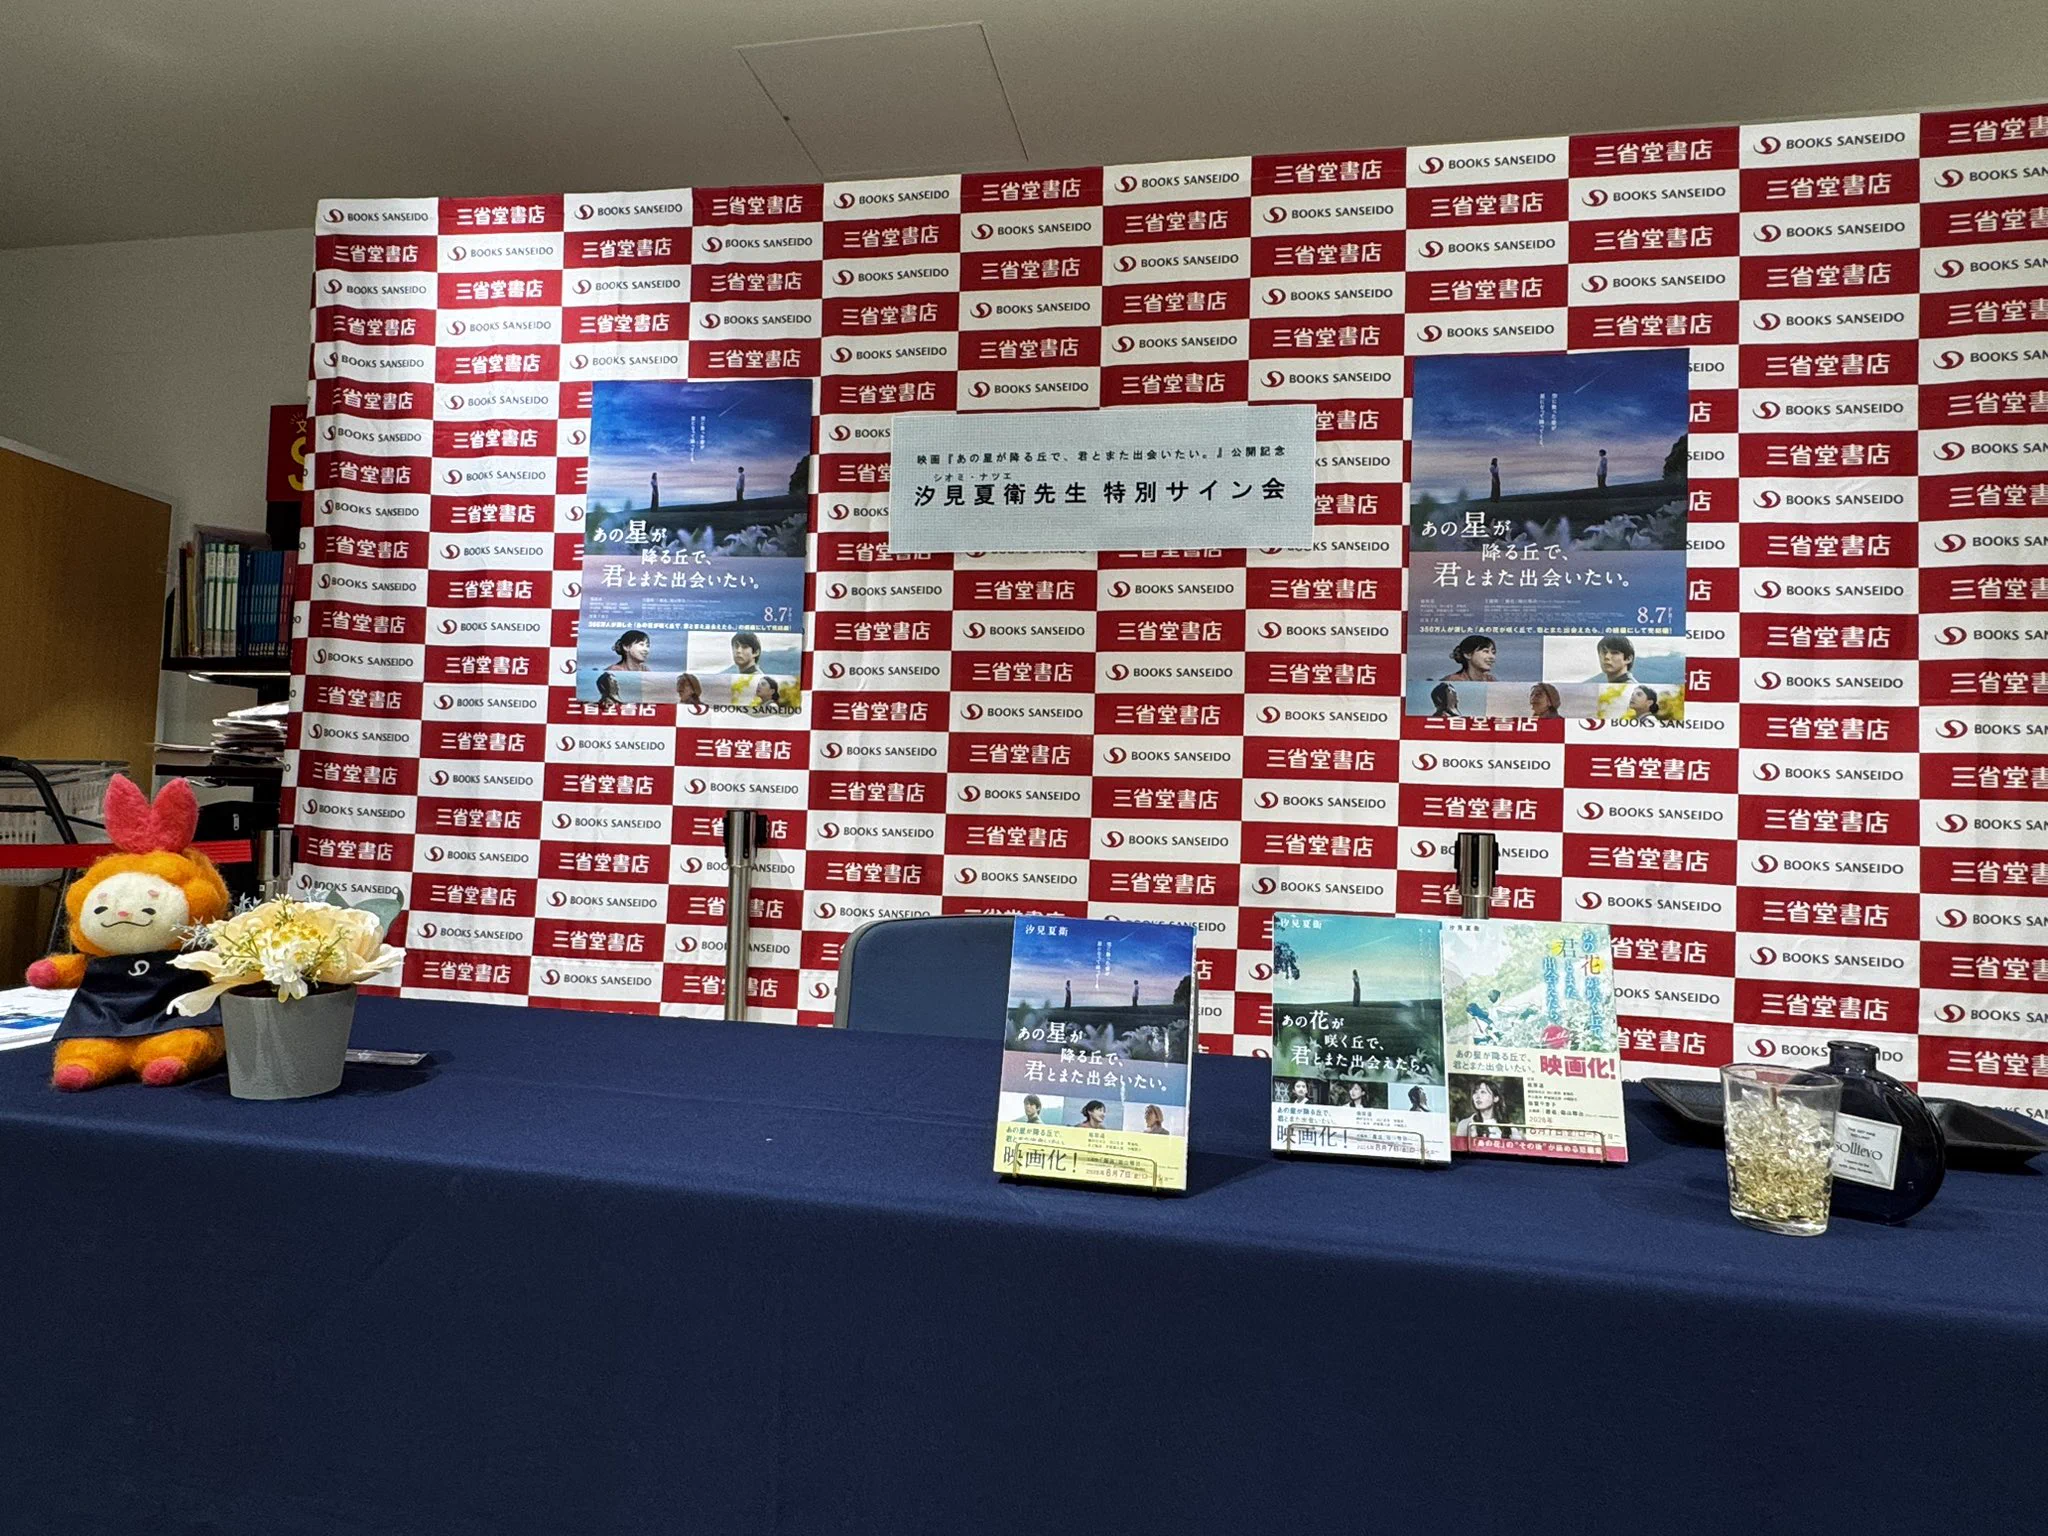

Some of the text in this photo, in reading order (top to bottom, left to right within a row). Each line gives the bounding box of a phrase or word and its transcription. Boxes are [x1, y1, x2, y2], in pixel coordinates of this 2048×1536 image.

[1786, 132, 1905, 149] BOOKS SANSEIDO
[1449, 153, 1556, 169] BOOKS SANSEIDO
[1593, 140, 1711, 164] 三省堂書店
[1142, 173, 1239, 188] BOOKS SANSEIDO
[1276, 160, 1380, 183] 三省堂書店
[984, 178, 1080, 201] 三省堂書店
[1766, 173, 1889, 199] 三省堂書店
[713, 195, 802, 215] 三省堂書店
[859, 190, 949, 205] BOOKS SANSEIDO
[598, 203, 683, 216] BOOKS SANSEIDO
[333, 245, 417, 262] 三省堂書店
[582, 238, 671, 258] 三省堂書店
[1766, 263, 1891, 287] 三省堂書店
[347, 285, 426, 295] BOOKS SANSEIDO
[1430, 278, 1540, 300] 三省堂書店
[1122, 291, 1226, 313] 三省堂書店
[724, 315, 812, 325] BOOKS SANSEIDO
[842, 304, 937, 325] 三省堂書店
[1447, 325, 1554, 337] BOOKS SANSEIDO
[1592, 314, 1711, 336] 三省堂書店
[1273, 326, 1380, 347] 三省堂書店
[981, 339, 1078, 358] 三省堂書店
[708, 349, 800, 368] 三省堂書店
[1765, 353, 1889, 376] 三省堂書店
[994, 382, 1089, 394] BOOKS SANSEIDO
[468, 396, 548, 406] BOOKS SANSEIDO
[1786, 403, 1904, 415] BOOKS SANSEIDO
[453, 429, 536, 448] 三省堂書店
[855, 428, 890, 438] BOOKS
[1766, 444, 1888, 466] 三省堂書店
[1971, 443, 2019, 454] BOOKS
[1332, 457, 1390, 467] SANSEIDO
[933, 472, 1012, 482] シオミ・ナツエ
[1316, 493, 1378, 515] 堂書店
[593, 520, 667, 544] あの星が
[1422, 511, 1511, 539] あの星が
[1482, 543, 1568, 562] 降る丘で、
[1686, 540, 1725, 550] SEIDO
[1766, 535, 1889, 557] 三省堂書店
[641, 549, 713, 567] 降る丘で、
[601, 564, 760, 590] 君とまた出会いたい。
[1433, 561, 1630, 588] 君とまた出会いたい。
[851, 586, 942, 596] BOOKS SANSEIDO
[975, 581, 1073, 600] 三省堂書店
[1135, 584, 1234, 594] BOOKS SANSEIDO
[1269, 579, 1376, 599] 三省堂書店
[1787, 585, 1904, 596] BOOKS SANSEIDO
[321, 611, 404, 633] 三省堂書店
[764, 607, 787, 622] 8.7
[1637, 606, 1666, 624] 8.7
[835, 622, 929, 641] 三省堂書店
[1118, 622, 1220, 641] 三省堂書店
[1766, 626, 1888, 648] 三省堂書店
[445, 656, 528, 674] 三省堂書店
[324, 728, 409, 742] BOOKS SANSEIDO
[1765, 718, 1888, 740] 三省堂書店
[579, 740, 665, 750] BOOKS SANSEIDO
[695, 739, 790, 759] 三省堂書店
[847, 747, 937, 756] BOOKS SANSEIDO
[969, 745, 1069, 764] 三省堂書店
[1131, 751, 1231, 761] BOOKS SANSEIDO
[1266, 749, 1374, 770] 三省堂書店
[1443, 758, 1551, 770] BOOKS SANSEIDO
[312, 762, 396, 784] 三省堂書店
[1589, 757, 1709, 781] 三省堂書店
[1785, 768, 1903, 781] BOOKS SANSEIDO
[563, 775, 652, 795] 三省堂書店
[1422, 797, 1536, 820] 三省堂書店
[1763, 809, 1888, 833] 三省堂書店
[447, 851, 529, 863] BOOKS SANSEIDO
[1588, 847, 1708, 872] 三省堂書店
[826, 863, 920, 883] 三省堂書店
[1110, 873, 1215, 894] 三省堂書店
[1281, 882, 1384, 895] BOOKS SANSEIDO
[688, 896, 784, 919] 三省書店
[840, 907, 930, 918] BOOKS SANSEIDO
[1608, 897, 1721, 912] BOOKS SANSEIDO
[1762, 901, 1888, 927] 三省堂書店
[1280, 919, 1322, 930] 汐見夏衛
[1973, 914, 2021, 926] BOOKS
[1025, 924, 1069, 937] 汐見夏衛
[1783, 953, 1904, 968] BOOKS SANSEIDO
[425, 962, 509, 983] 三省堂書店
[564, 974, 652, 986] BOOKS SANSEIDO
[1760, 994, 1888, 1021] 三省堂書店
[1281, 1009, 1344, 1030] あの花が
[1017, 1022, 1083, 1044] あの星が
[1324, 1034, 1385, 1051] 咲く丘で、
[1060, 1049, 1124, 1067] 降る丘で、
[1291, 1046, 1427, 1072] 君とまた出会えたら。
[1456, 1050, 1532, 1063] あの星が降る丘で、
[1024, 1060, 1168, 1092] 君とまた出会いたい。
[1453, 1060, 1537, 1074] 君とまた出会いたい。
[1540, 1054, 1617, 1081] 映画化!
